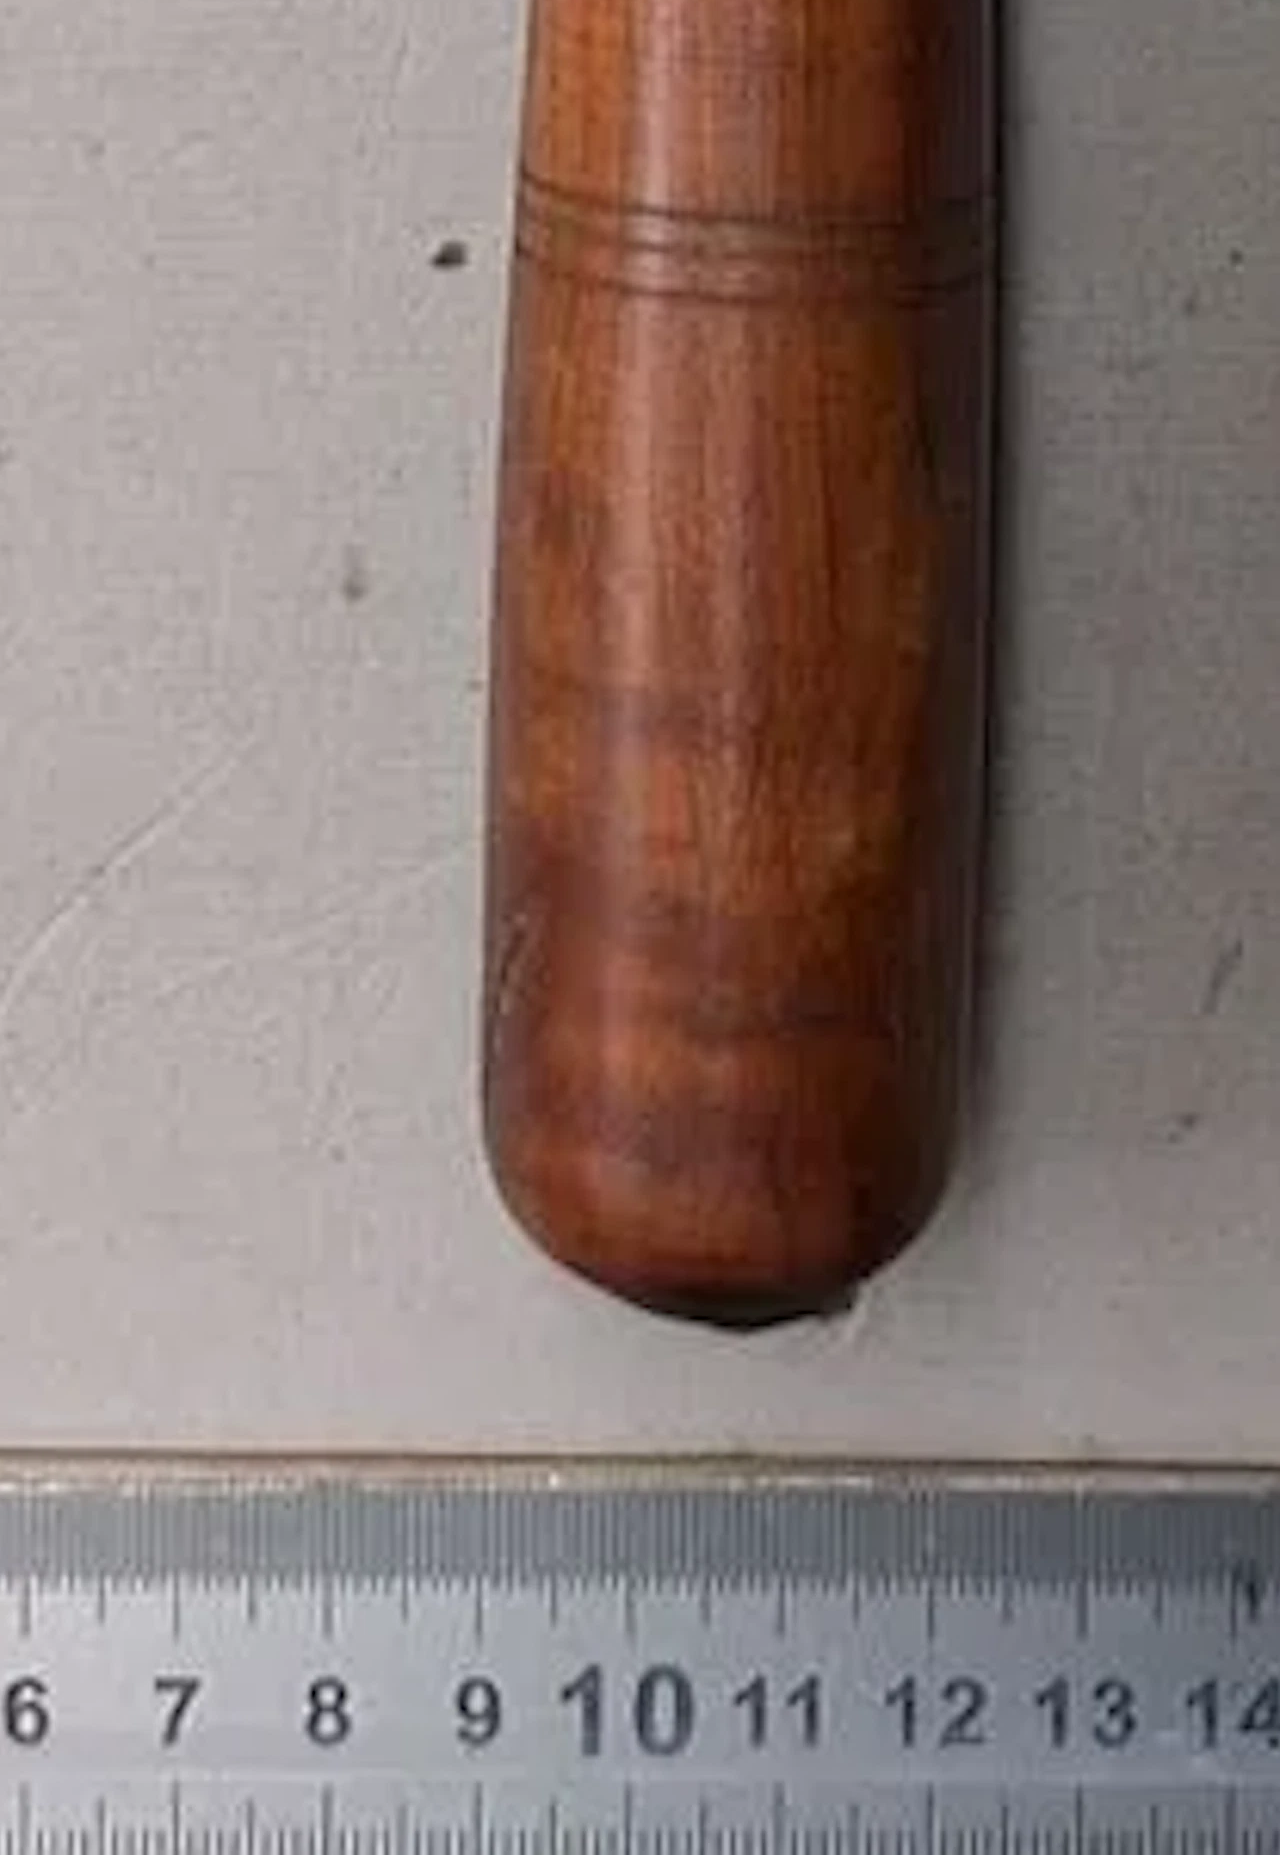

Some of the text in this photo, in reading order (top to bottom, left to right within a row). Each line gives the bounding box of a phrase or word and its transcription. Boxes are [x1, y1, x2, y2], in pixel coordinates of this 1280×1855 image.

[3, 1676, 49, 1745] 6
[155, 1678, 200, 1746] 7
[305, 1678, 351, 1746] 8
[456, 1678, 501, 1746] 9
[561, 1664, 695, 1756] 10
[733, 1675, 820, 1747] 11
[886, 1676, 987, 1747] 12
[1035, 1678, 1137, 1748] 13
